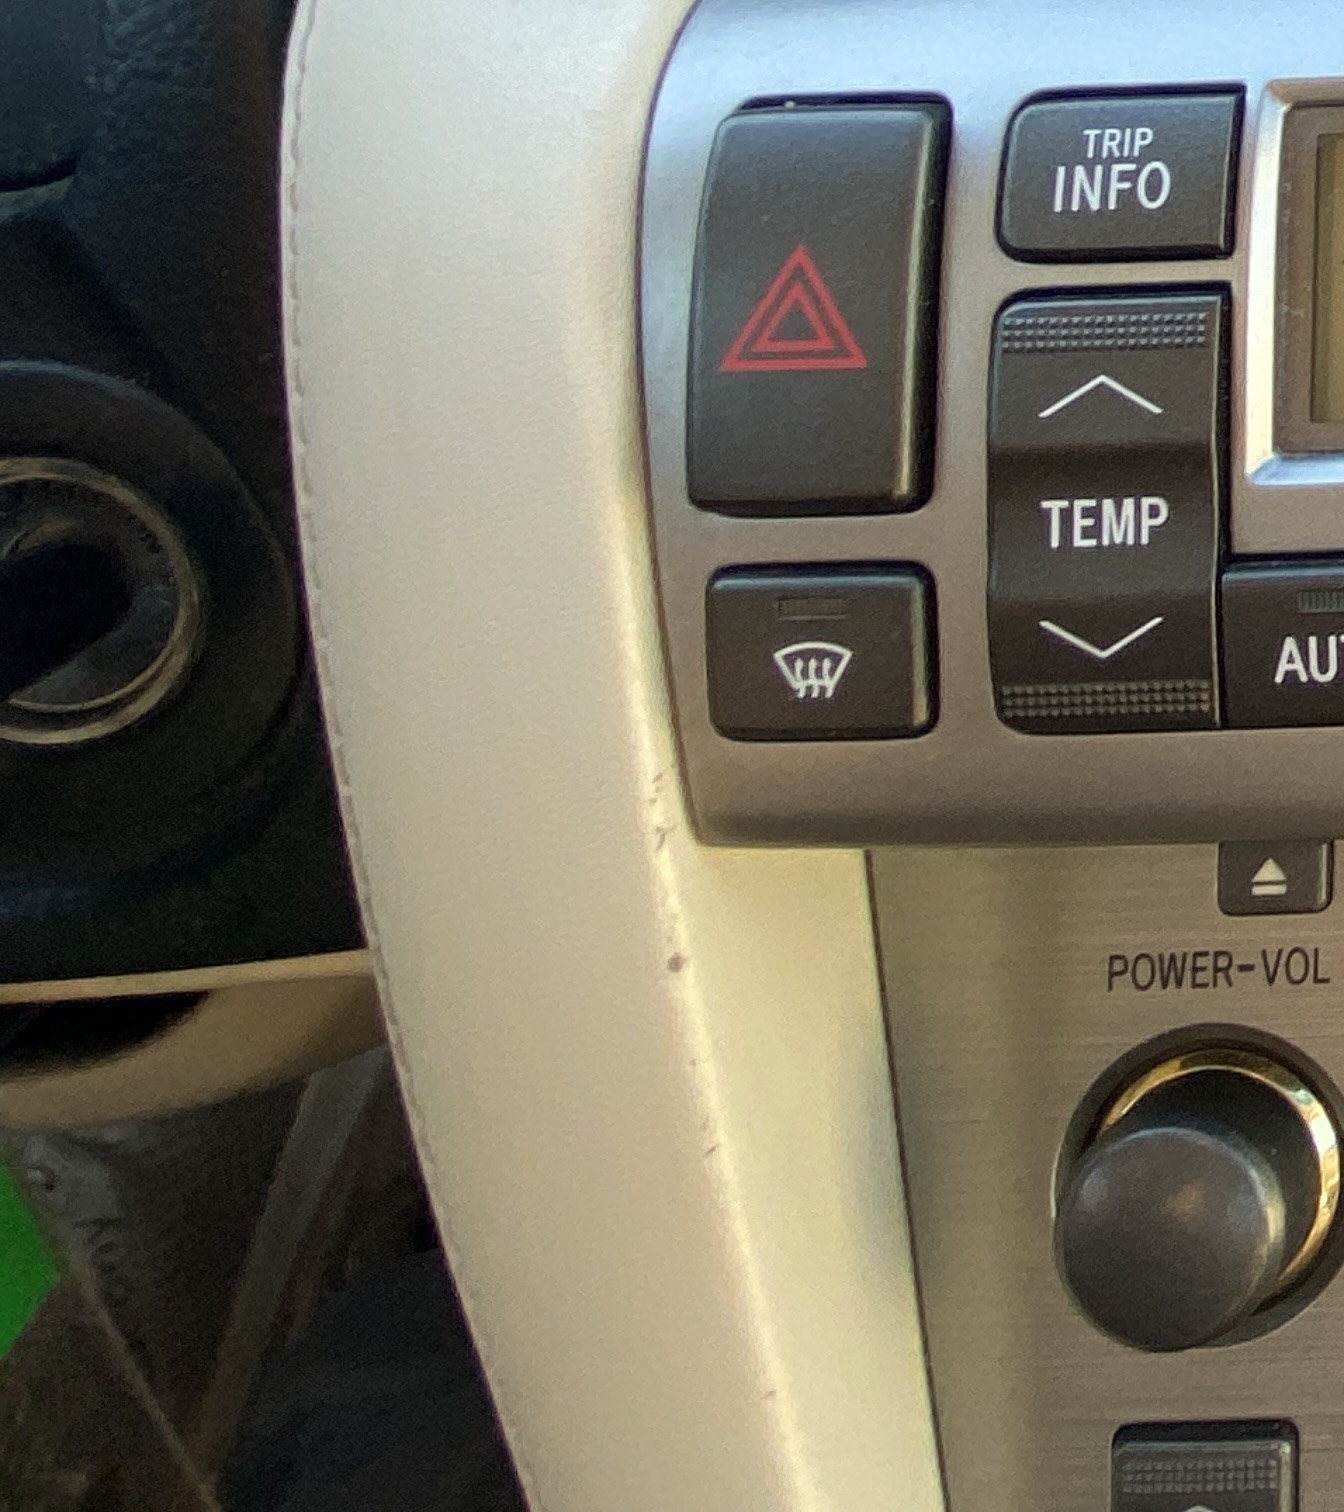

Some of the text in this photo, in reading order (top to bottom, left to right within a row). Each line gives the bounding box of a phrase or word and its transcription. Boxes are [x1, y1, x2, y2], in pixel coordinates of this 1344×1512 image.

[1082, 127, 1154, 159] TRIP
[1052, 161, 1172, 214] INFO
[1039, 496, 1170, 550] TEMP
[1106, 947, 1331, 993] POWER-VOL
